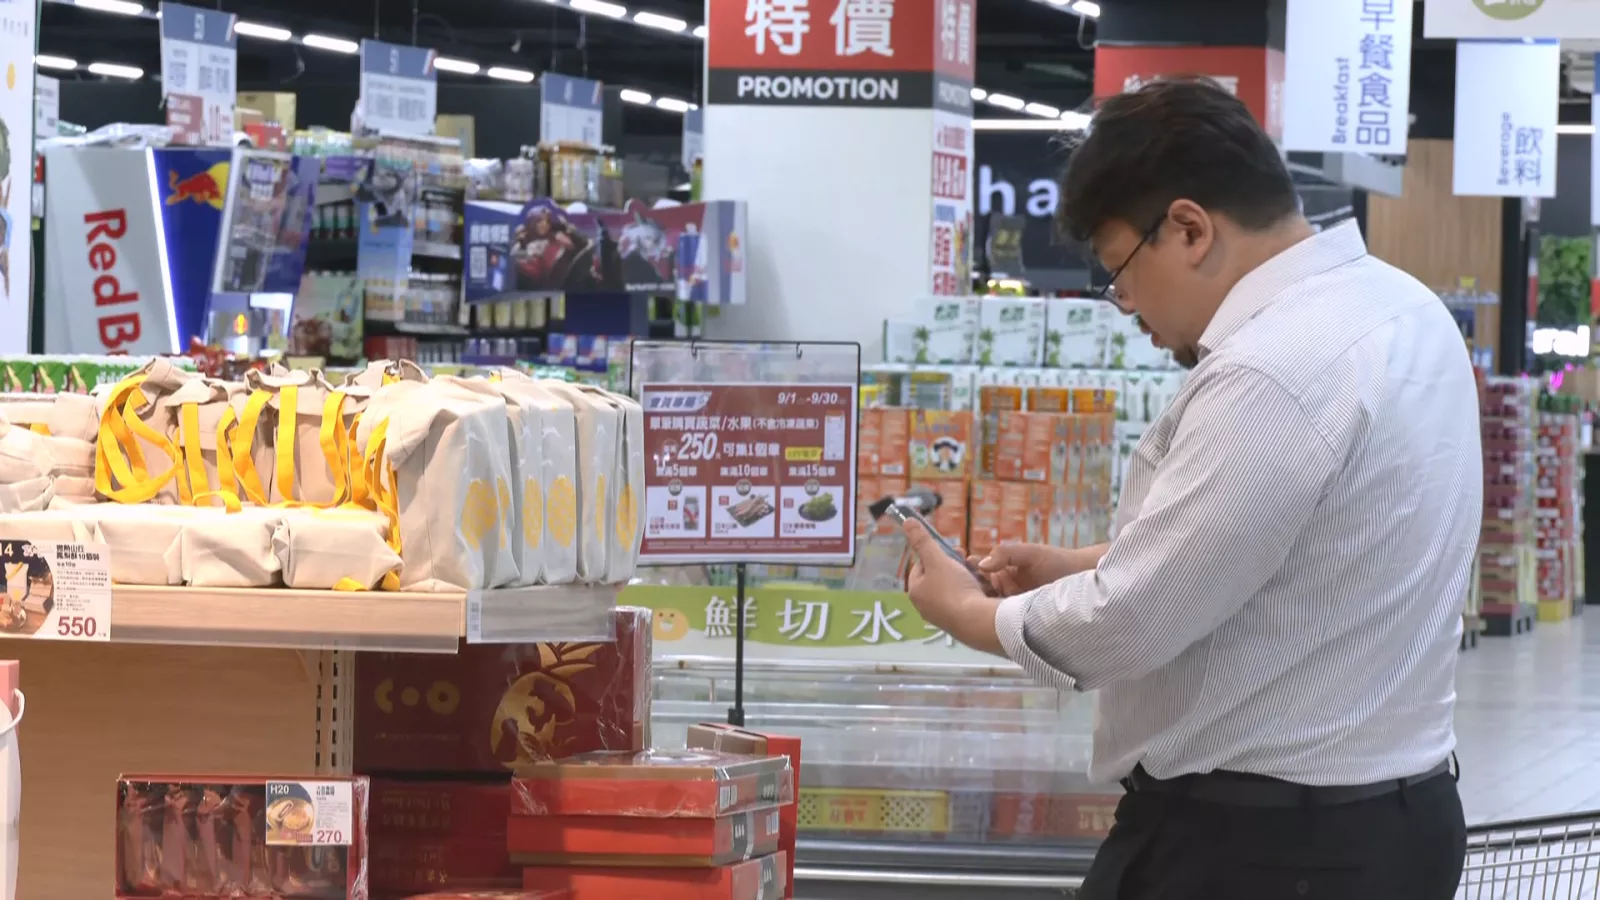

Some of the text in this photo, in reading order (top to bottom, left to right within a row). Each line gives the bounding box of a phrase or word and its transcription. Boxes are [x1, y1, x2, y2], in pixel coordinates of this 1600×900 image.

[744, 0, 895, 57] 特價
[737, 76, 899, 100] PROMOTION
[1356, 0, 1396, 146] 早餐食品
[1331, 57, 1350, 144] Breakfast
[1514, 127, 1543, 186] 飲料
[84, 208, 140, 308] Red
[677, 432, 718, 460] 250
[58, 616, 97, 637] 550
[704, 595, 954, 648] 鮮切水
[270, 784, 290, 795] H20
[316, 830, 342, 843] 270
